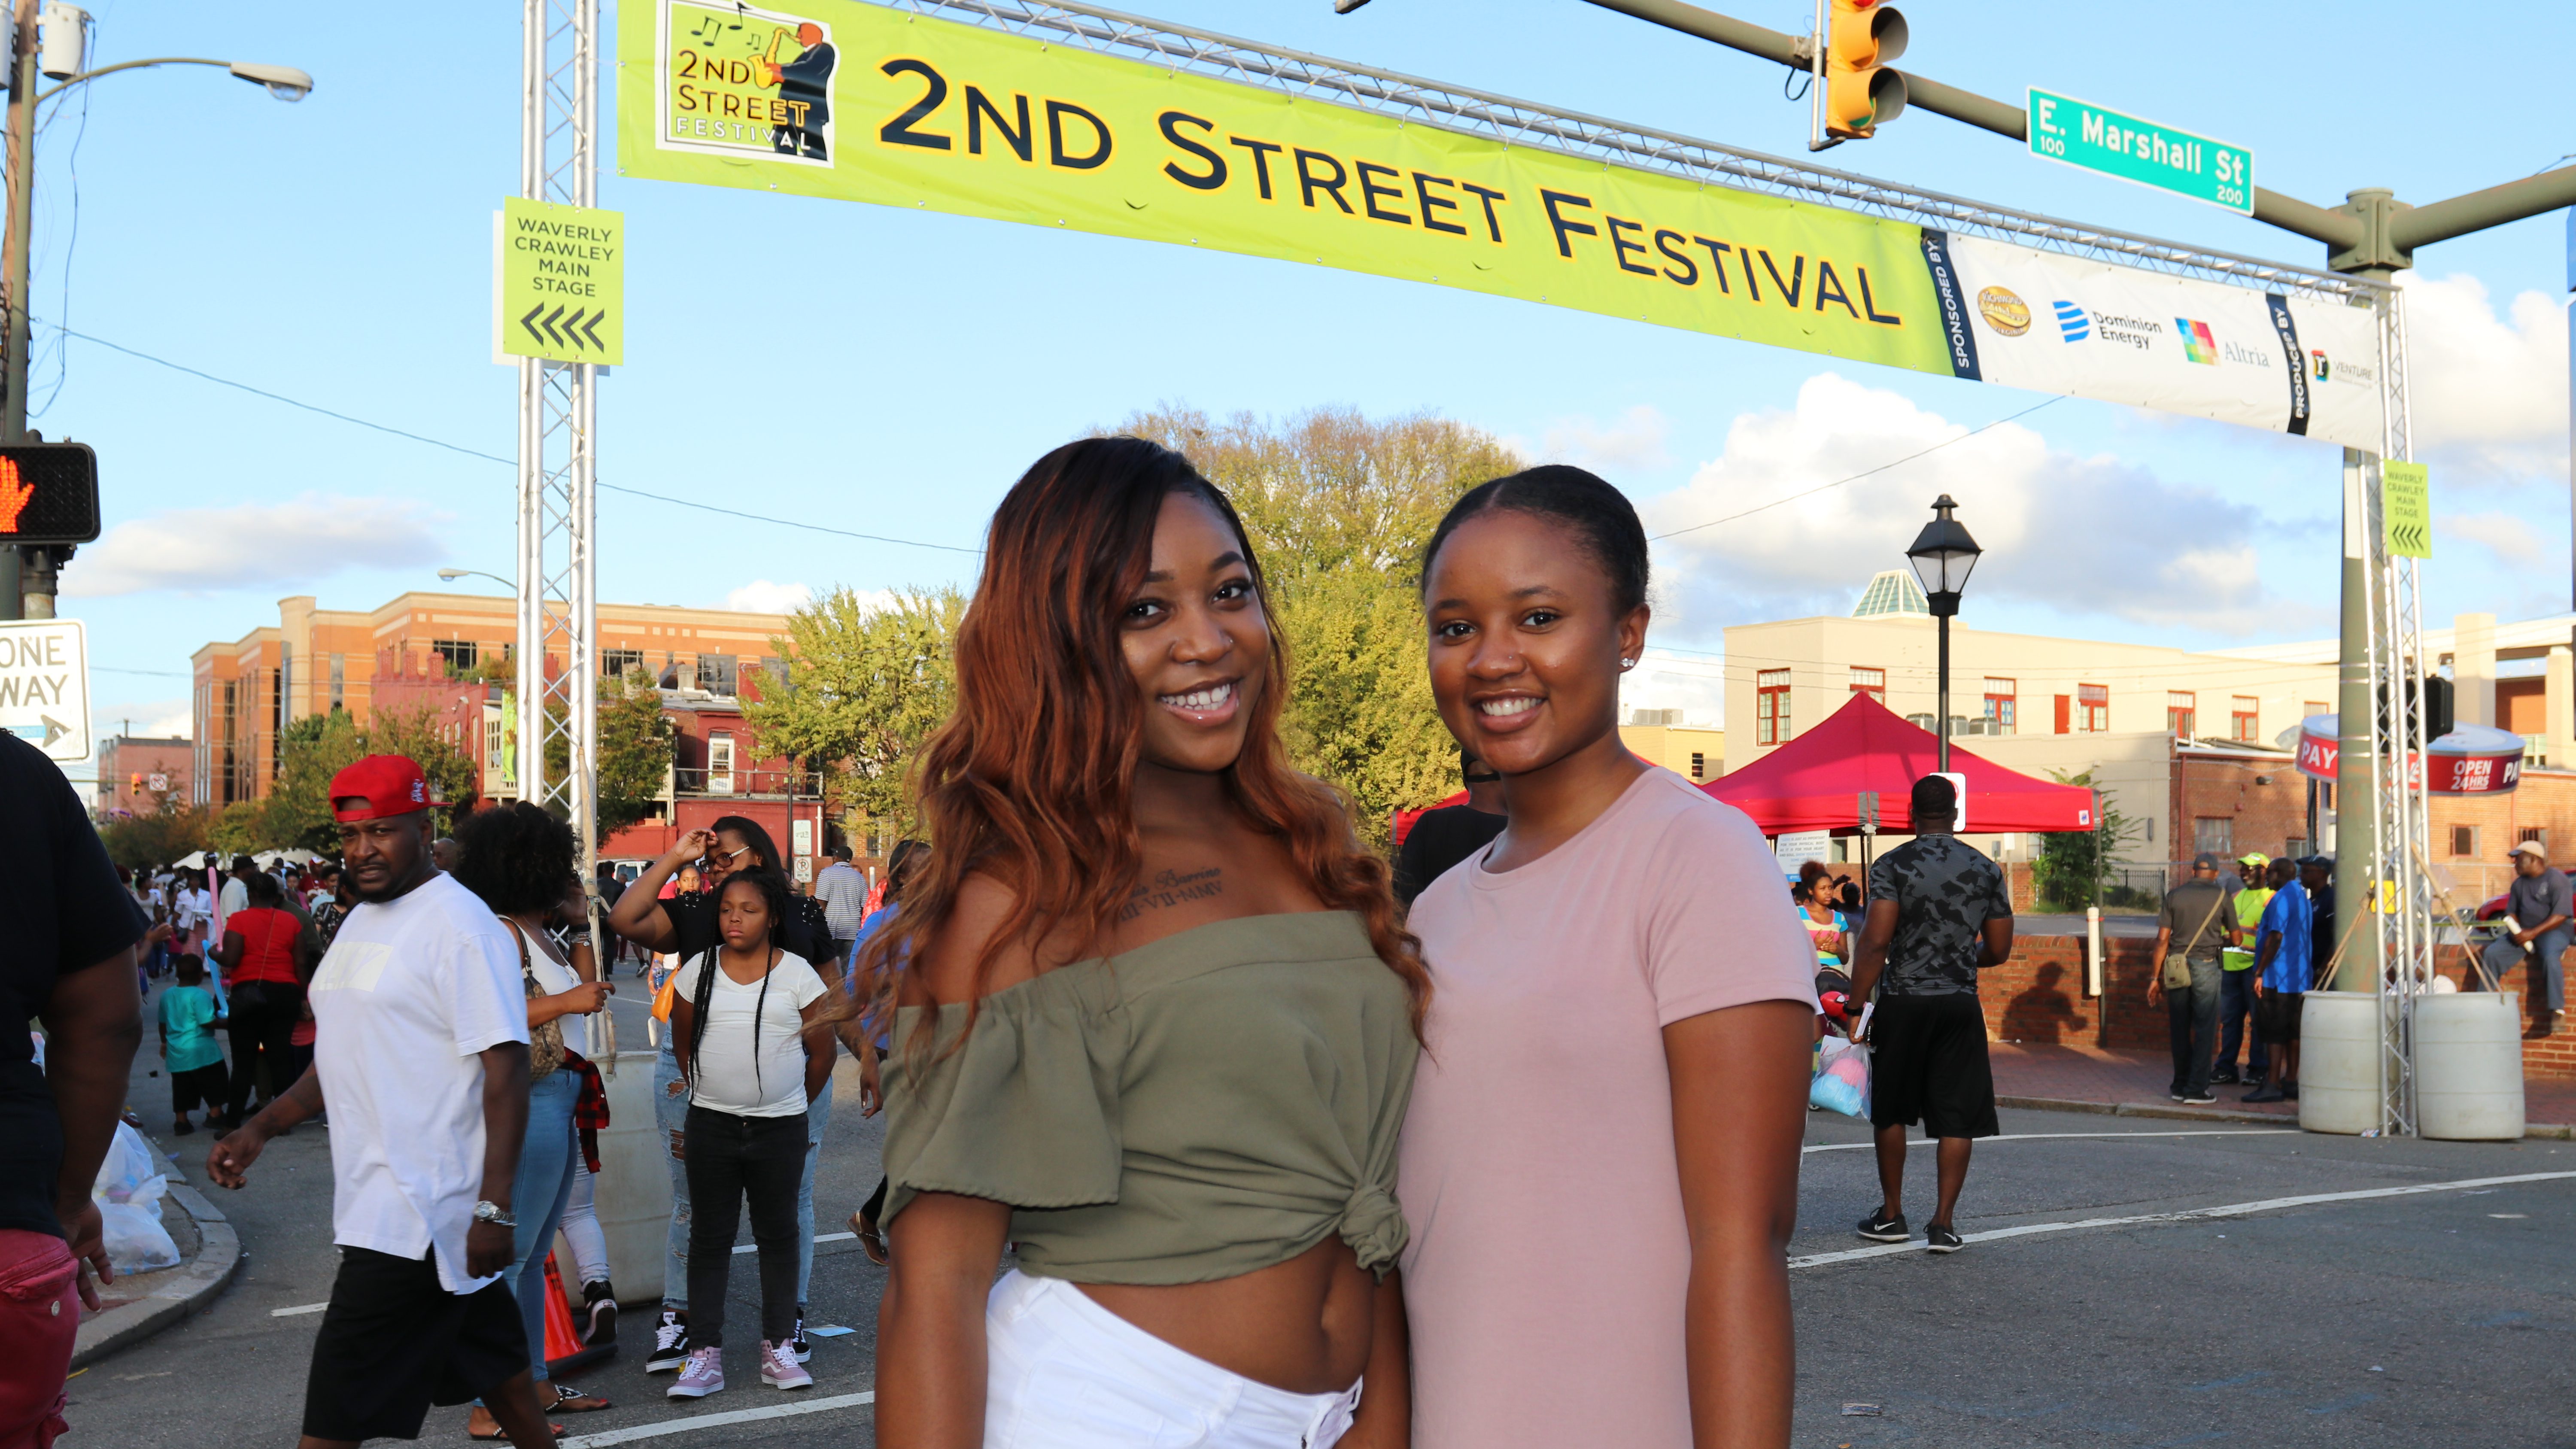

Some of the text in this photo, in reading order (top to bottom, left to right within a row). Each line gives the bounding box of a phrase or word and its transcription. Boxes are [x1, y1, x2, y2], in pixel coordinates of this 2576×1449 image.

[677, 49, 750, 85] 2ND
[677, 84, 811, 129] STREET
[675, 116, 811, 151] FESTIVAL
[2038, 97, 2244, 186] E. Marshall St
[2039, 134, 2065, 156] 100
[880, 58, 1902, 325] 2ND STREET FESTIVAL
[2216, 185, 2243, 206] 200
[517, 216, 613, 243] WAVERLY
[514, 236, 614, 261] CRAWLEY
[538, 258, 590, 278] MAIN
[532, 276, 596, 298] STAGE
[1927, 240, 1970, 369] SPONSORED BY
[2092, 310, 2163, 333] Dominion
[2099, 325, 2149, 350] Energy
[2225, 340, 2270, 368] Altria
[2274, 307, 2305, 419] PRODUCED BY
[2333, 360, 2373, 381] VENTURE
[2387, 482, 2425, 496] CRAWLEY
[2388, 471, 2424, 484] WAVERLY
[2395, 506, 2420, 519] STAGE
[2396, 495, 2416, 506] MAIN
[0, 635, 66, 668] ONE
[0, 674, 69, 708] WAY
[2301, 741, 2338, 769] PAY
[2454, 759, 2493, 776] OPEN
[2450, 775, 2491, 790] 24HRS
